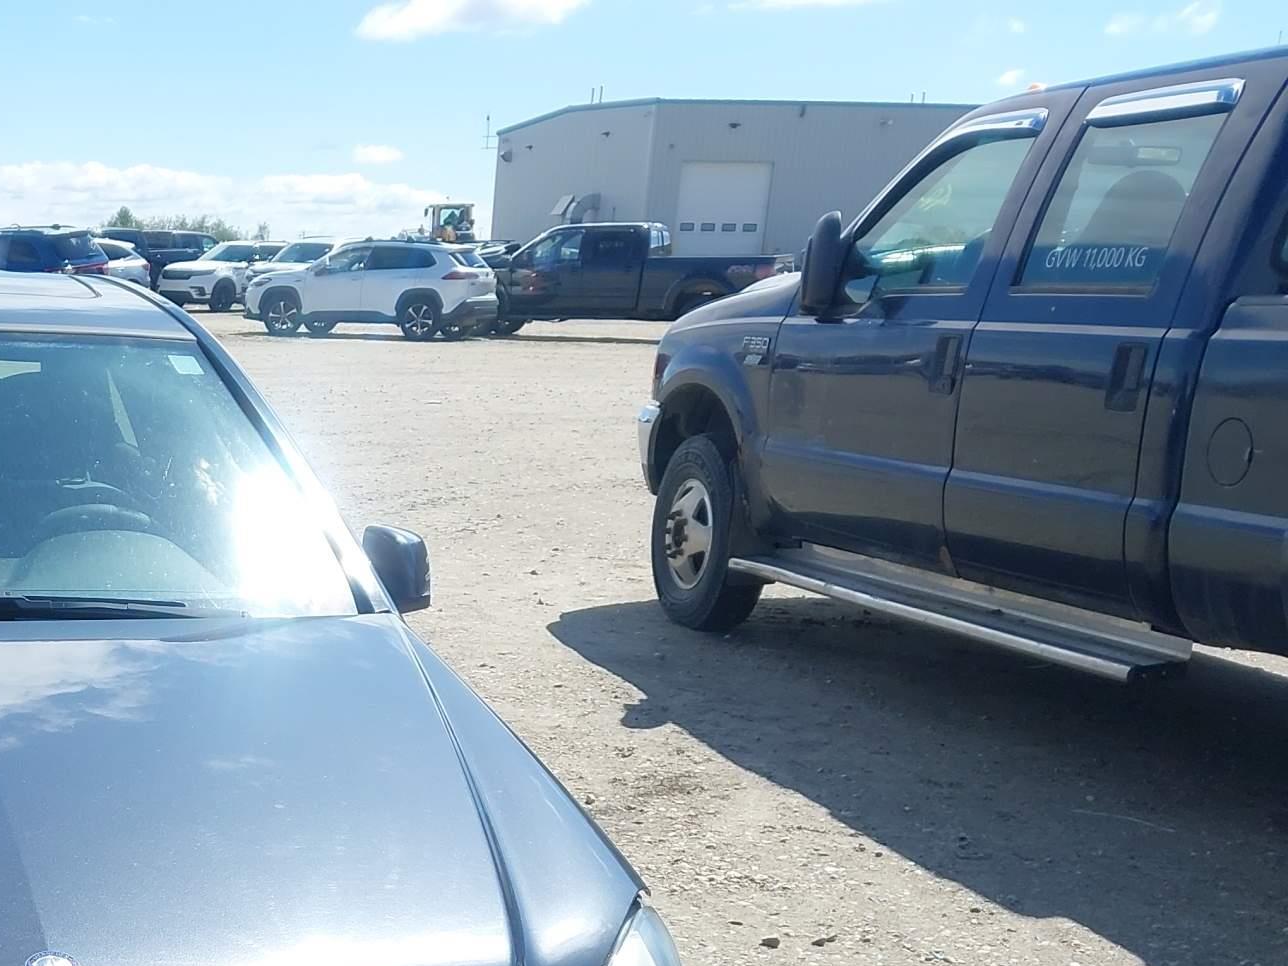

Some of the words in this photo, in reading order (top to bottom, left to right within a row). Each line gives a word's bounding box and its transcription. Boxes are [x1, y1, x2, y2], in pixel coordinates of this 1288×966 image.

[1046, 247, 1083, 268] GVW
[1083, 247, 1125, 270] 11,000
[1124, 247, 1149, 268] KG
